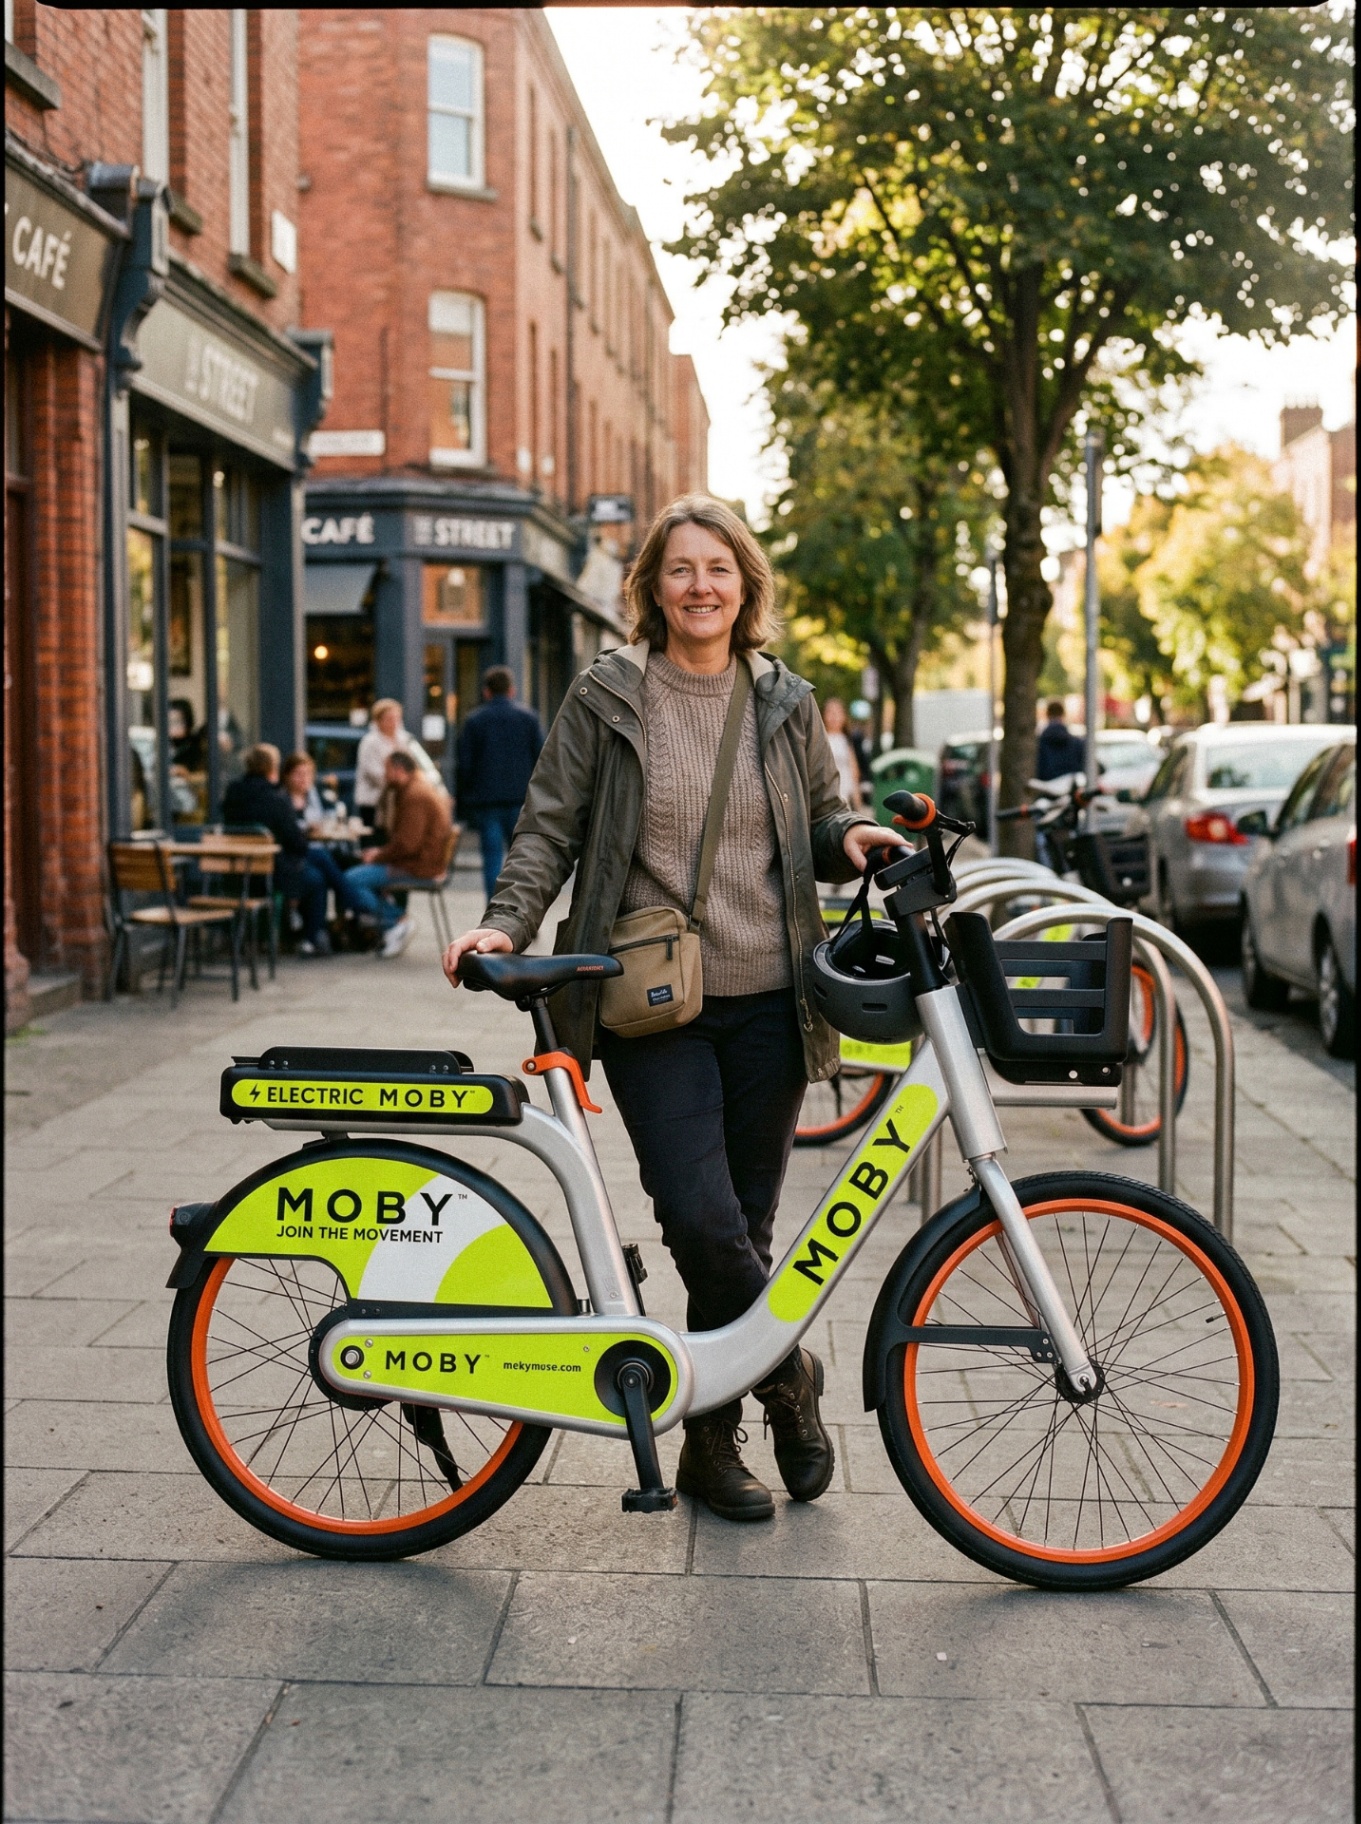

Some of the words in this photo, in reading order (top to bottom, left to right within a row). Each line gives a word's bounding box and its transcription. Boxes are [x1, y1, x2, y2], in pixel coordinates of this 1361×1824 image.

[12, 215, 72, 290] CAFÉ
[300, 511, 375, 545] CAFÉ
[434, 517, 516, 550] STREET
[267, 1086, 364, 1106] ELECTRIC
[276, 1225, 314, 1238] JOIN
[318, 1226, 349, 1240] THE
[353, 1227, 443, 1244] MOVEMENT
[503, 1361, 582, 1373] mekymuse.com
